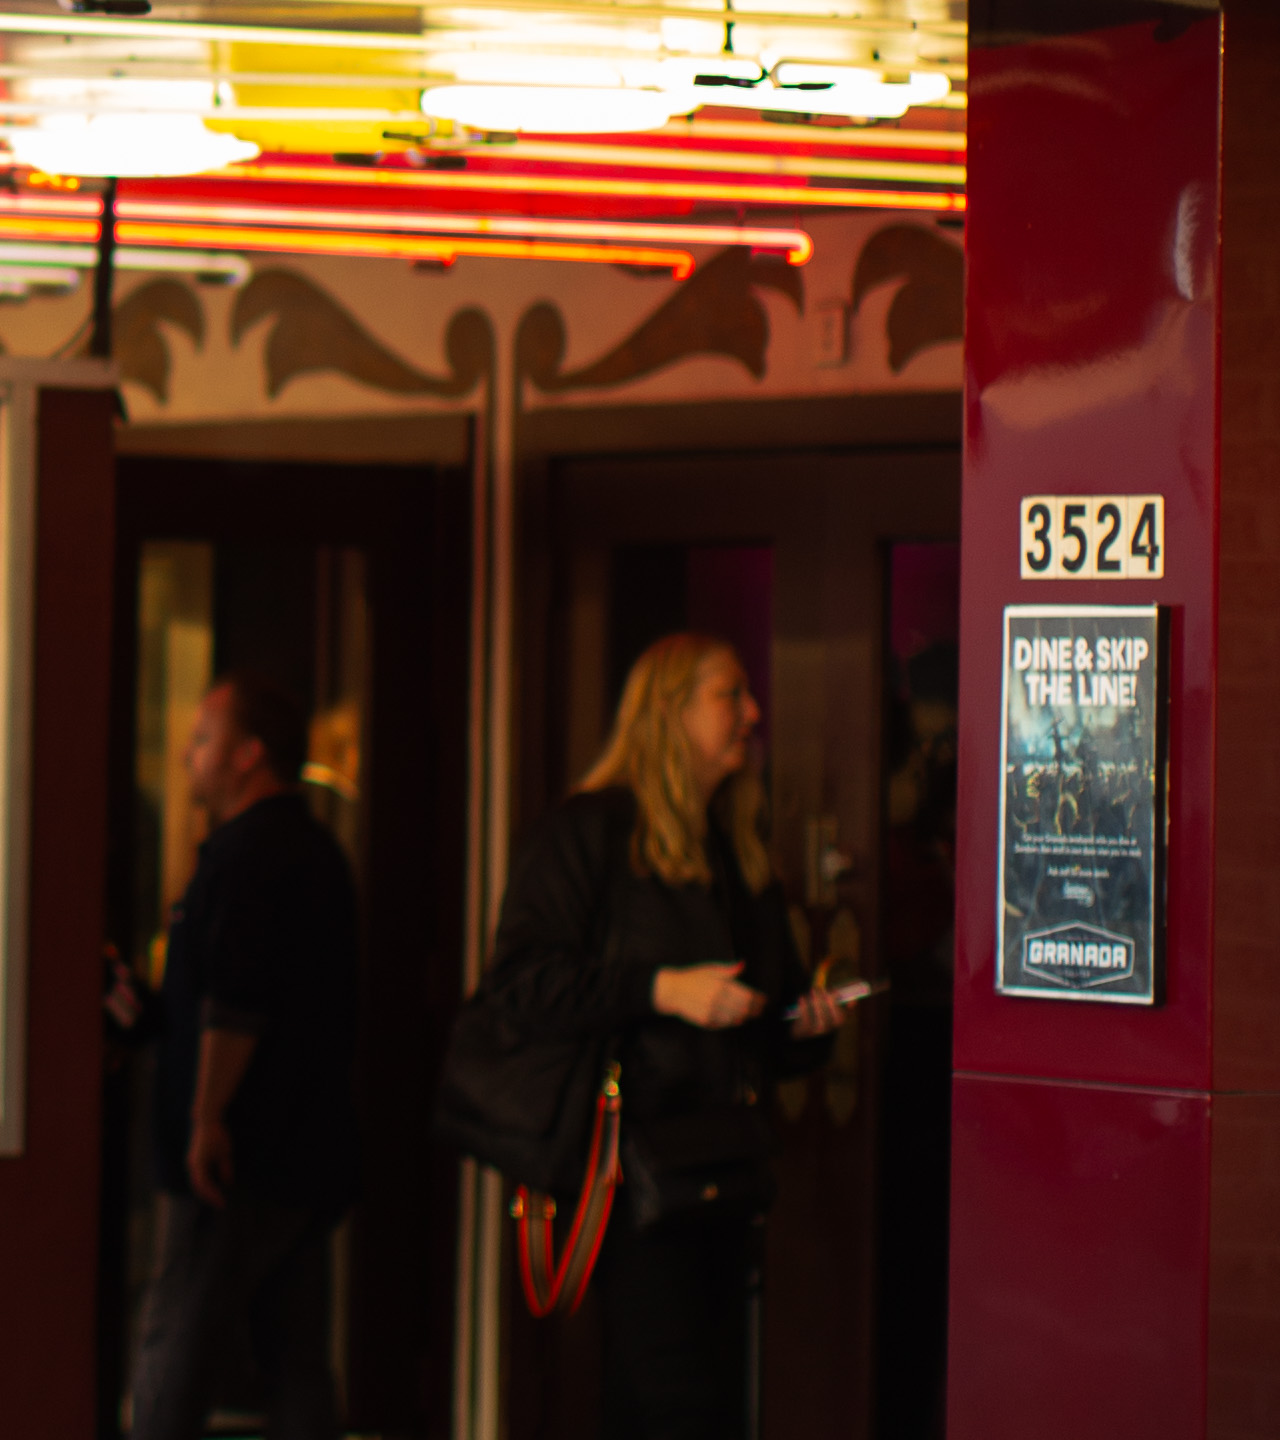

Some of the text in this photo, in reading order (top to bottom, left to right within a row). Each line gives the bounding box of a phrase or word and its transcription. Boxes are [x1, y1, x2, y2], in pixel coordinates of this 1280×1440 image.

[1026, 503, 1160, 572] 3524
[1014, 636, 1149, 671] DINE & SKIP
[1025, 673, 1138, 707] THE LINE!
[1029, 940, 1127, 968] GRANADA
